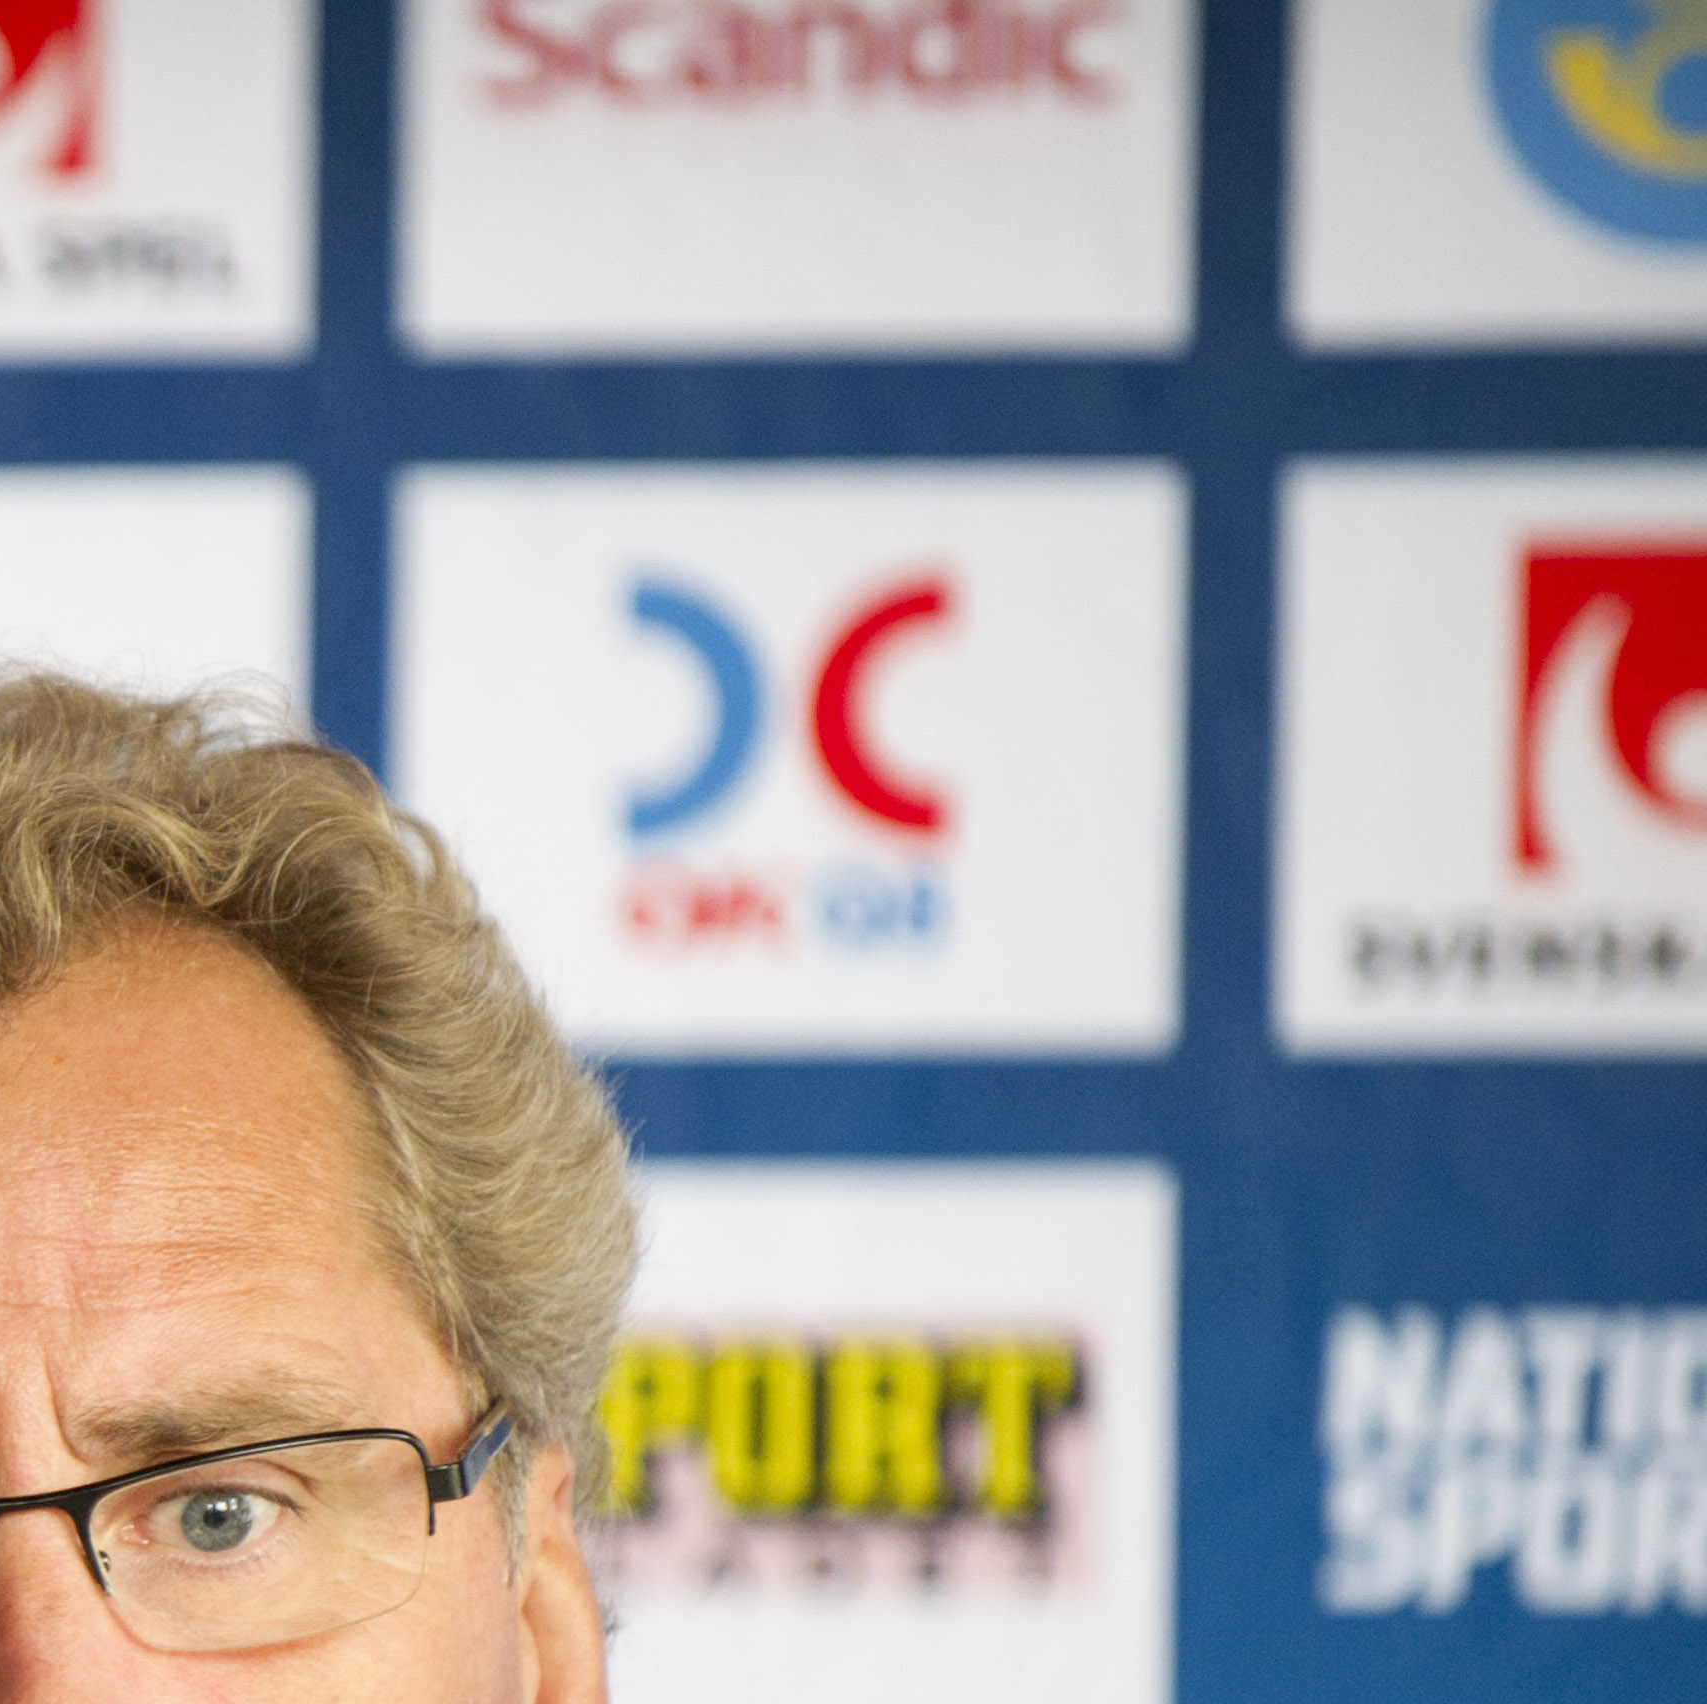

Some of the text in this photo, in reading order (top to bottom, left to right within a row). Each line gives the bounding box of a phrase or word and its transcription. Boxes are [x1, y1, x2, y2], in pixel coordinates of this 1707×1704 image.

[477, 0, 1127, 112] Scandic
[1349, 912, 1707, 992] SVENSK
[587, 1328, 1087, 1520] PORT
